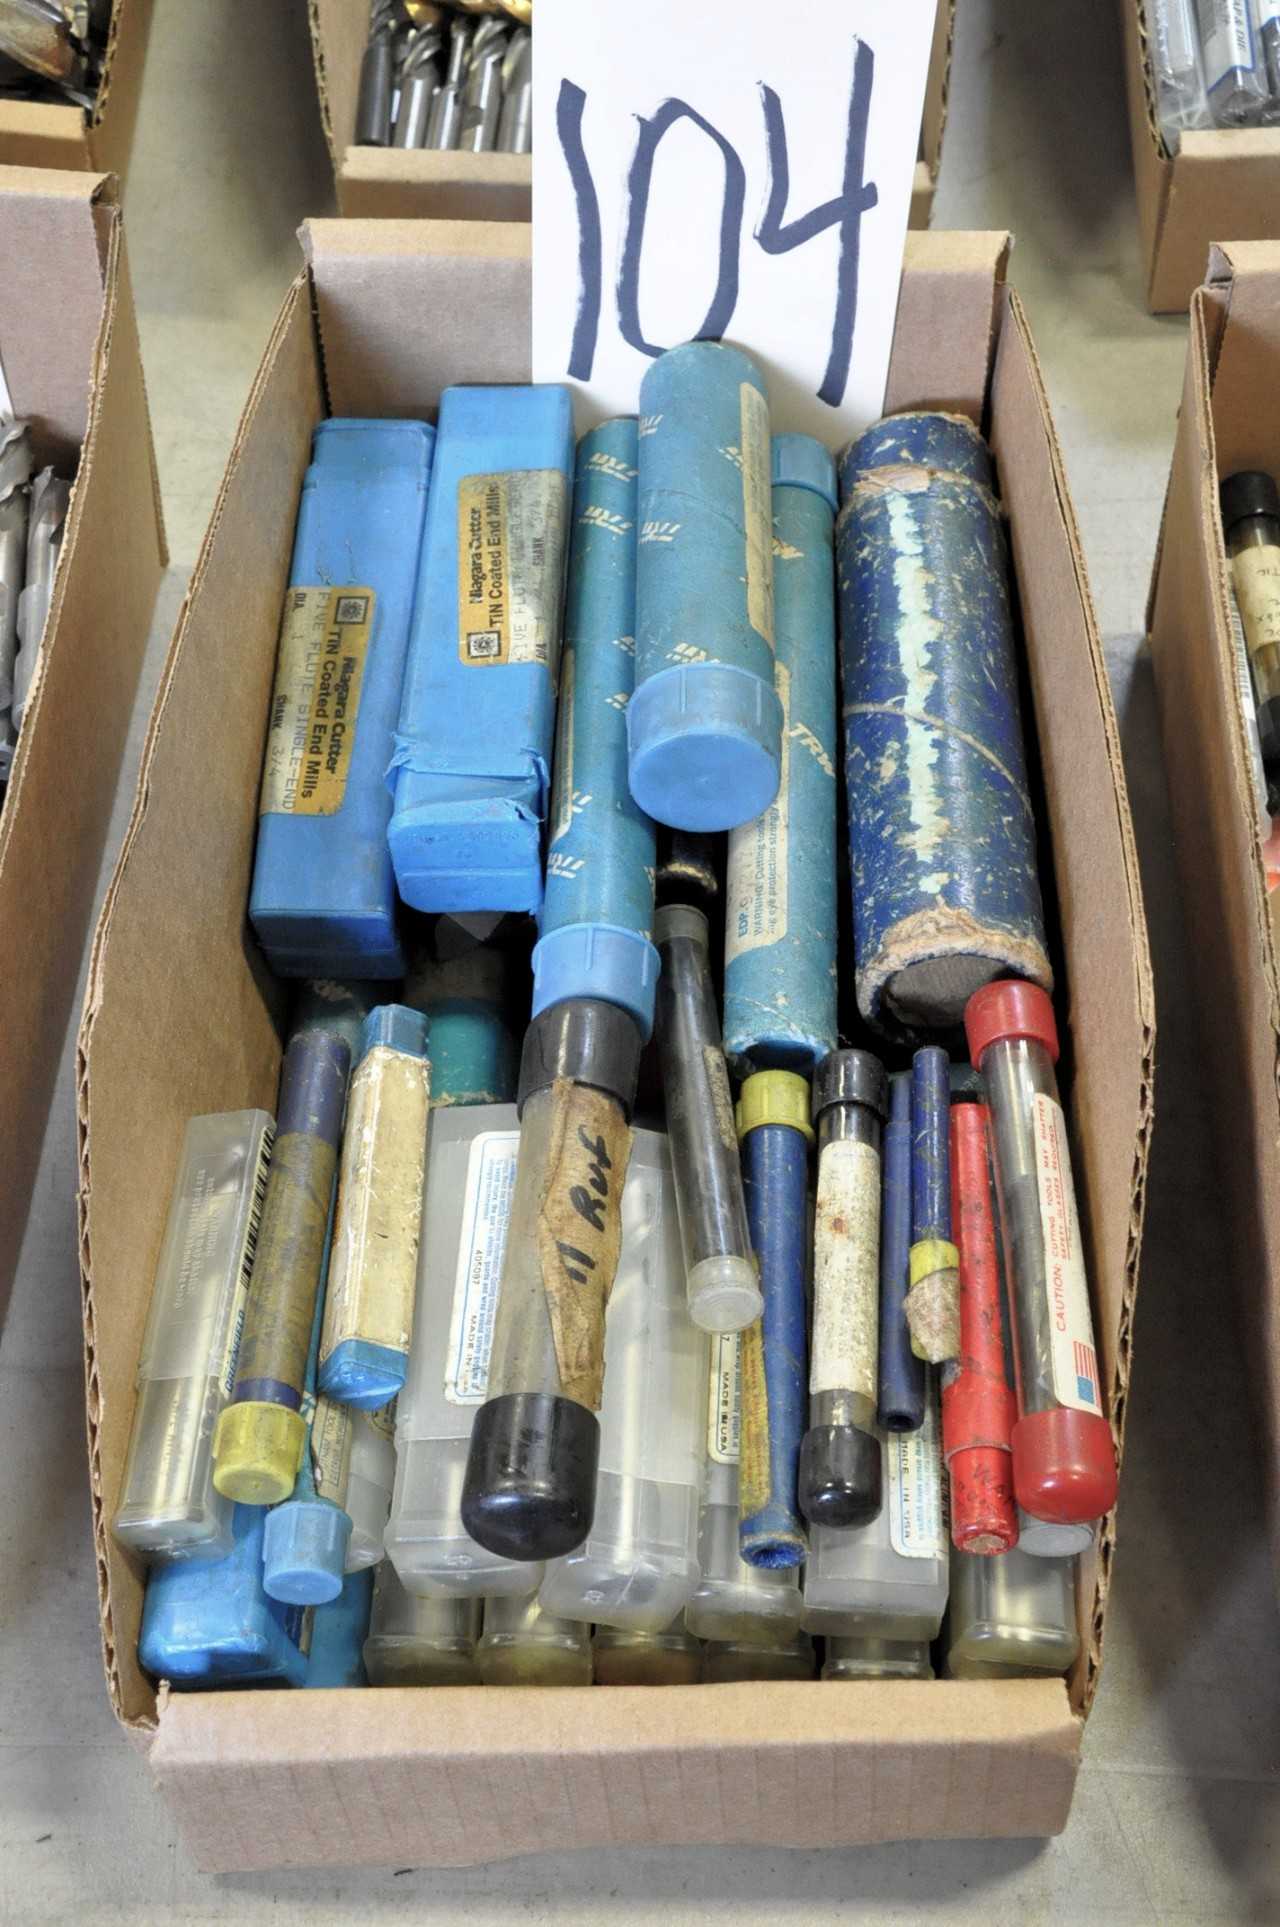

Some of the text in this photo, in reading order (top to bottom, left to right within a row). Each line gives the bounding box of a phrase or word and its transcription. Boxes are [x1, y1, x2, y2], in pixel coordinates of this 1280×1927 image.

[557, 34, 877, 407] 104
[486, 485, 500, 517] Mills
[487, 520, 501, 546] End
[532, 537, 545, 567] SHANK
[469, 508, 486, 604] Niagara Cutter
[488, 551, 503, 599] Coated
[282, 591, 329, 810] FIVE FLUTE SINGLE-END
[315, 660, 337, 718] Coated
[271, 694, 288, 730] SHANK
[326, 657, 356, 774] Niagara Cutter
[309, 724, 326, 754] End
[301, 760, 320, 799] Mills
[755, 842, 766, 880] Cutting
[768, 847, 777, 896] protection
[768, 898, 776, 915] eye
[1042, 1148, 1050, 1168] MAY
[1045, 1177, 1053, 1206] TOOLS
[1047, 1215, 1059, 1258] CUTTING
[1052, 1263, 1066, 1332] CAUTION:
[721, 1371, 729, 1407] MADE
[720, 1427, 728, 1451] USA
